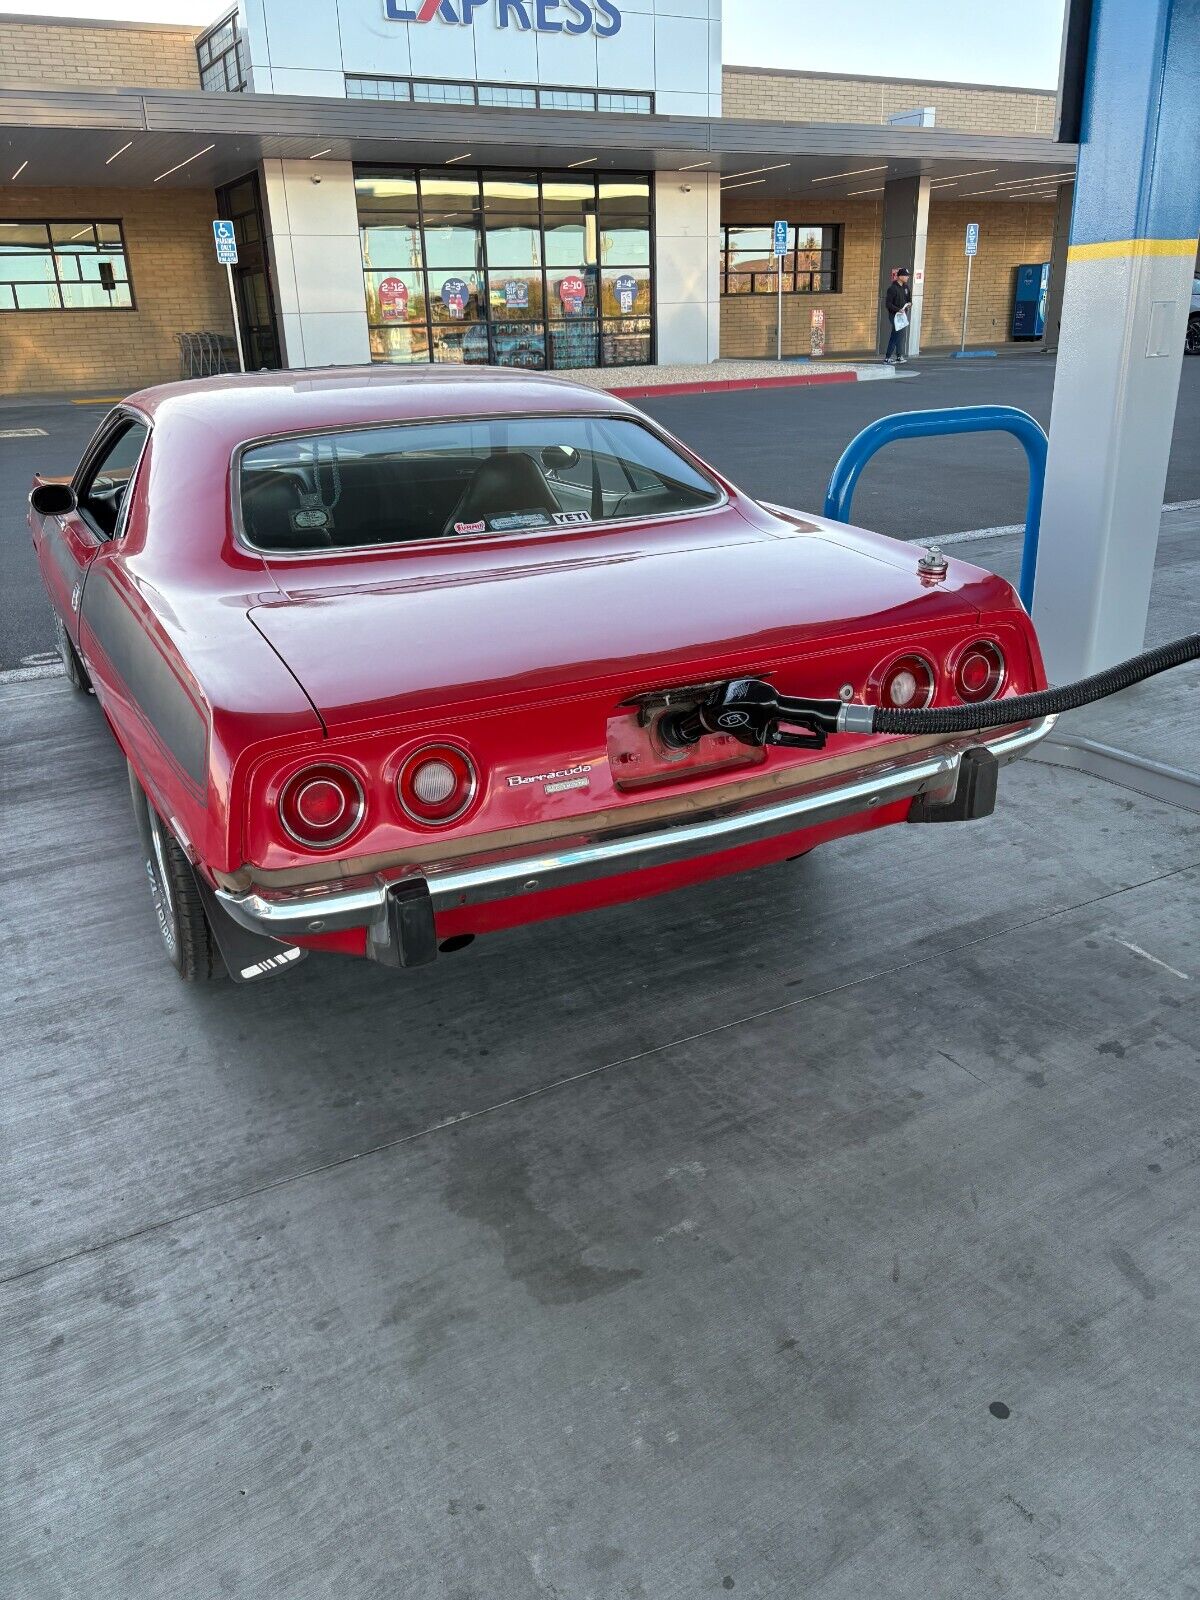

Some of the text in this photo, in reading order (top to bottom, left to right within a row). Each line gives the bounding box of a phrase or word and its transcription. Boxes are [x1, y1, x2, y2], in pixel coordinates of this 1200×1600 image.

[382, 283, 388, 292] 2
[445, 283, 451, 291] 2
[563, 281, 568, 289] 2
[616, 280, 621, 288] 2
[555, 513, 589, 523] YETI
[506, 765, 592, 786] Barracuda
